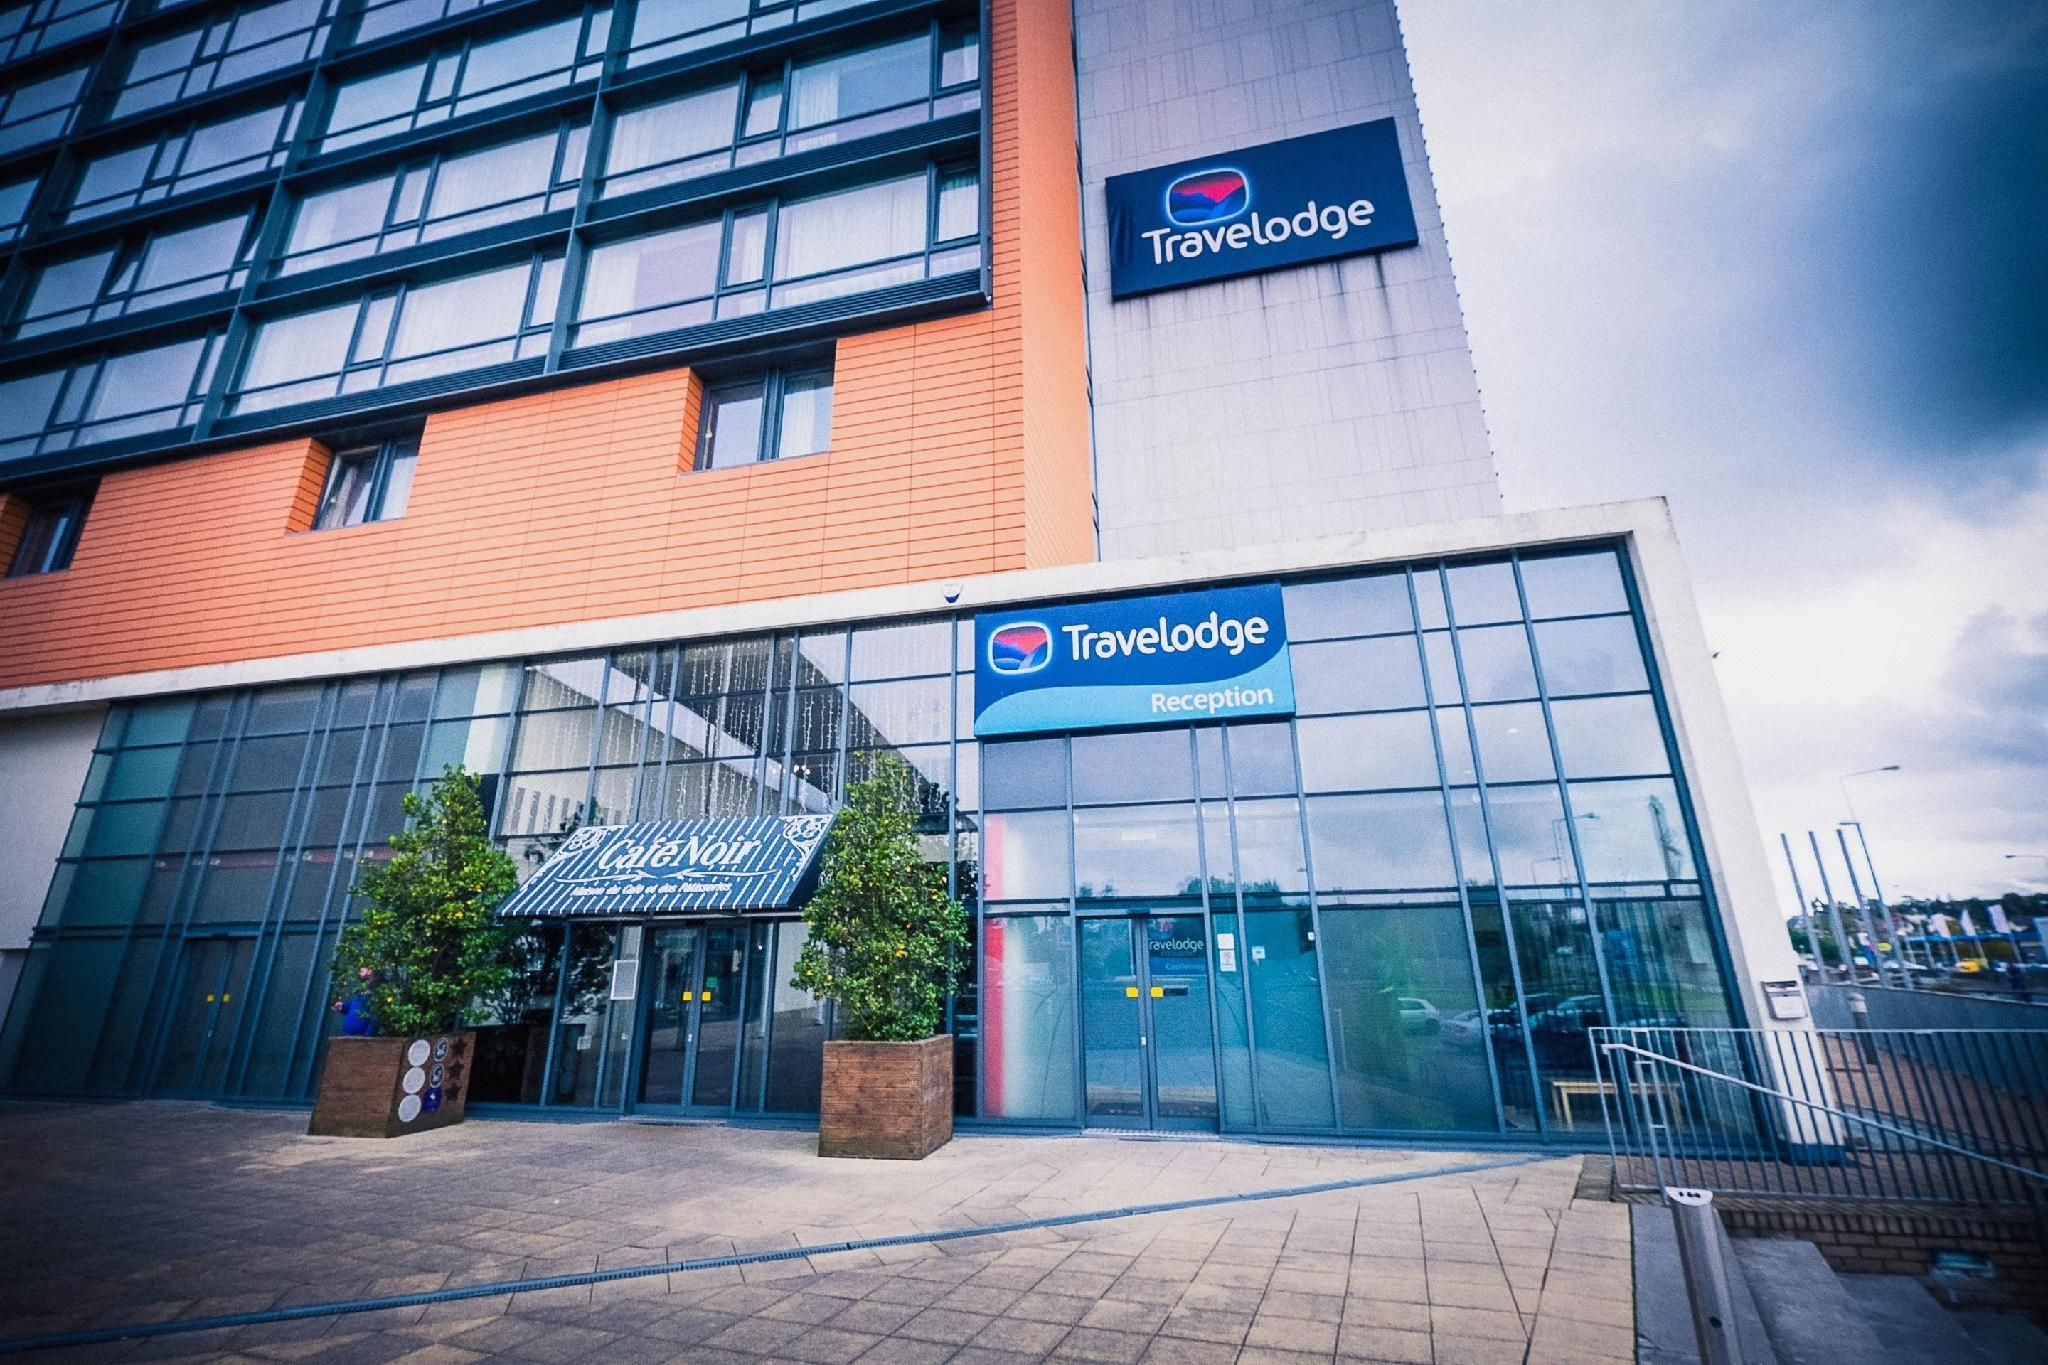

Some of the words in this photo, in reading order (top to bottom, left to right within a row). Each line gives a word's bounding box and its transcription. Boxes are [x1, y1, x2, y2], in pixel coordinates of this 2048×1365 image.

[1141, 199, 1376, 265] Travelodge
[1061, 611, 1270, 661] Travelodge
[1151, 685, 1274, 714] Reception
[669, 834, 762, 867] Noir
[1149, 937, 1204, 952] ravelodge
